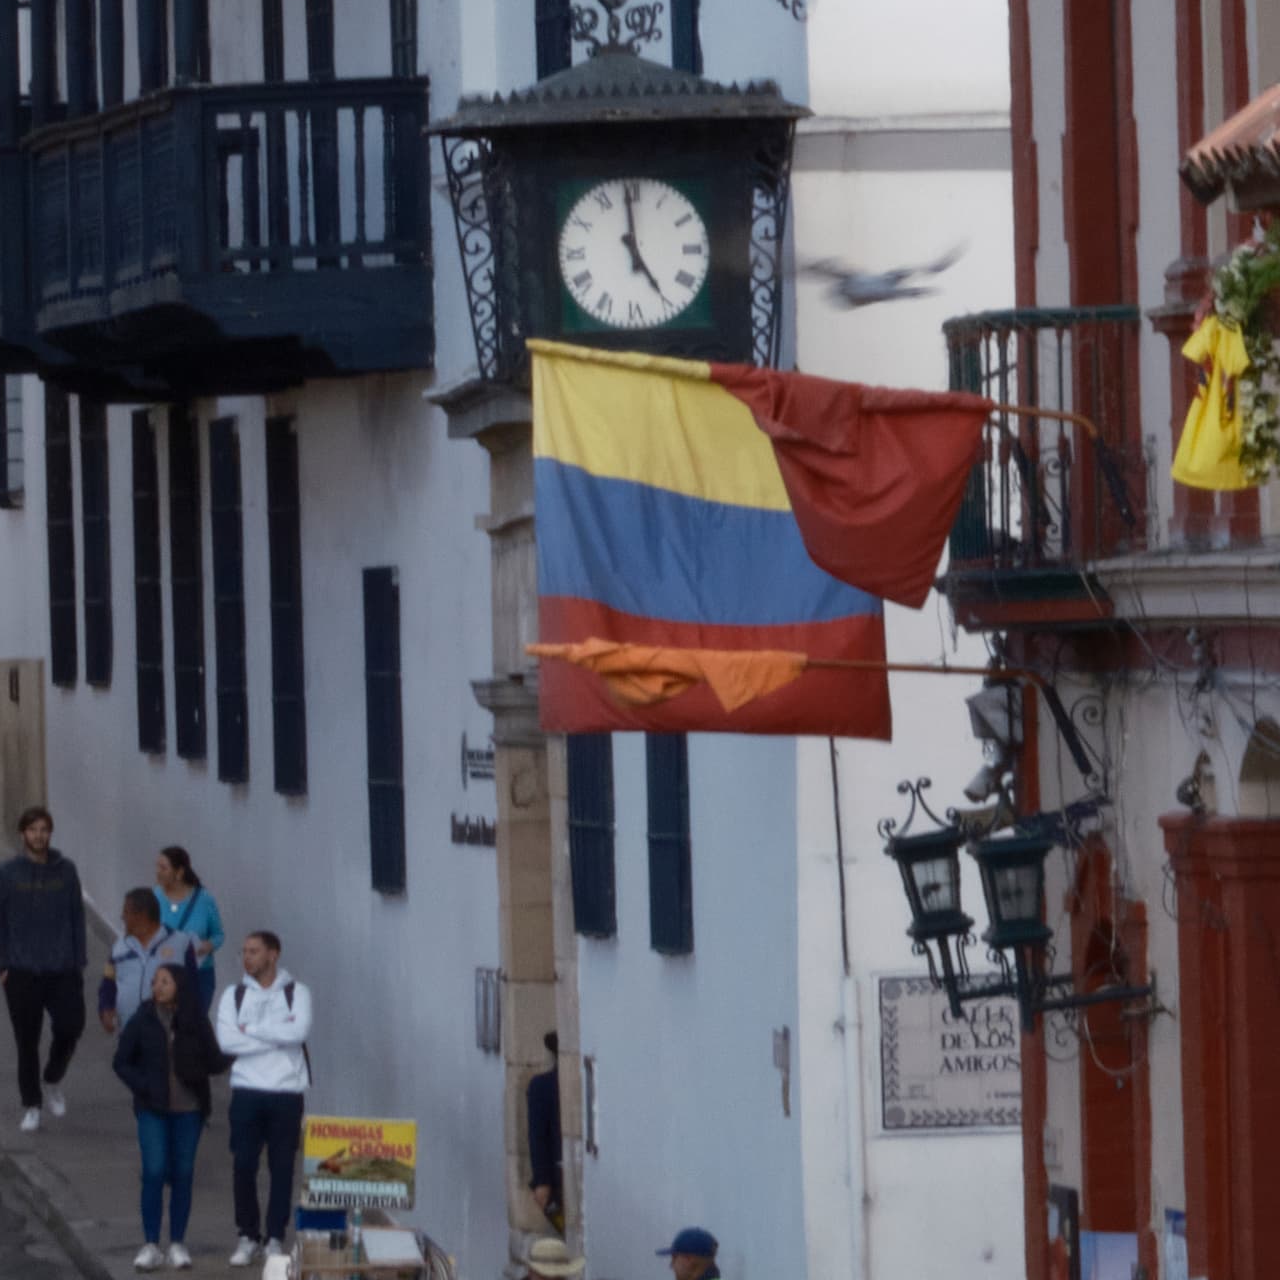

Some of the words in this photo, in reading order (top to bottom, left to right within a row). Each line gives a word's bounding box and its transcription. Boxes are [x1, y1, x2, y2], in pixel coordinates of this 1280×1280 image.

[941, 1033, 966, 1050] DE
[972, 1033, 1015, 1050] LOS
[940, 1054, 1022, 1073] AMIGOS
